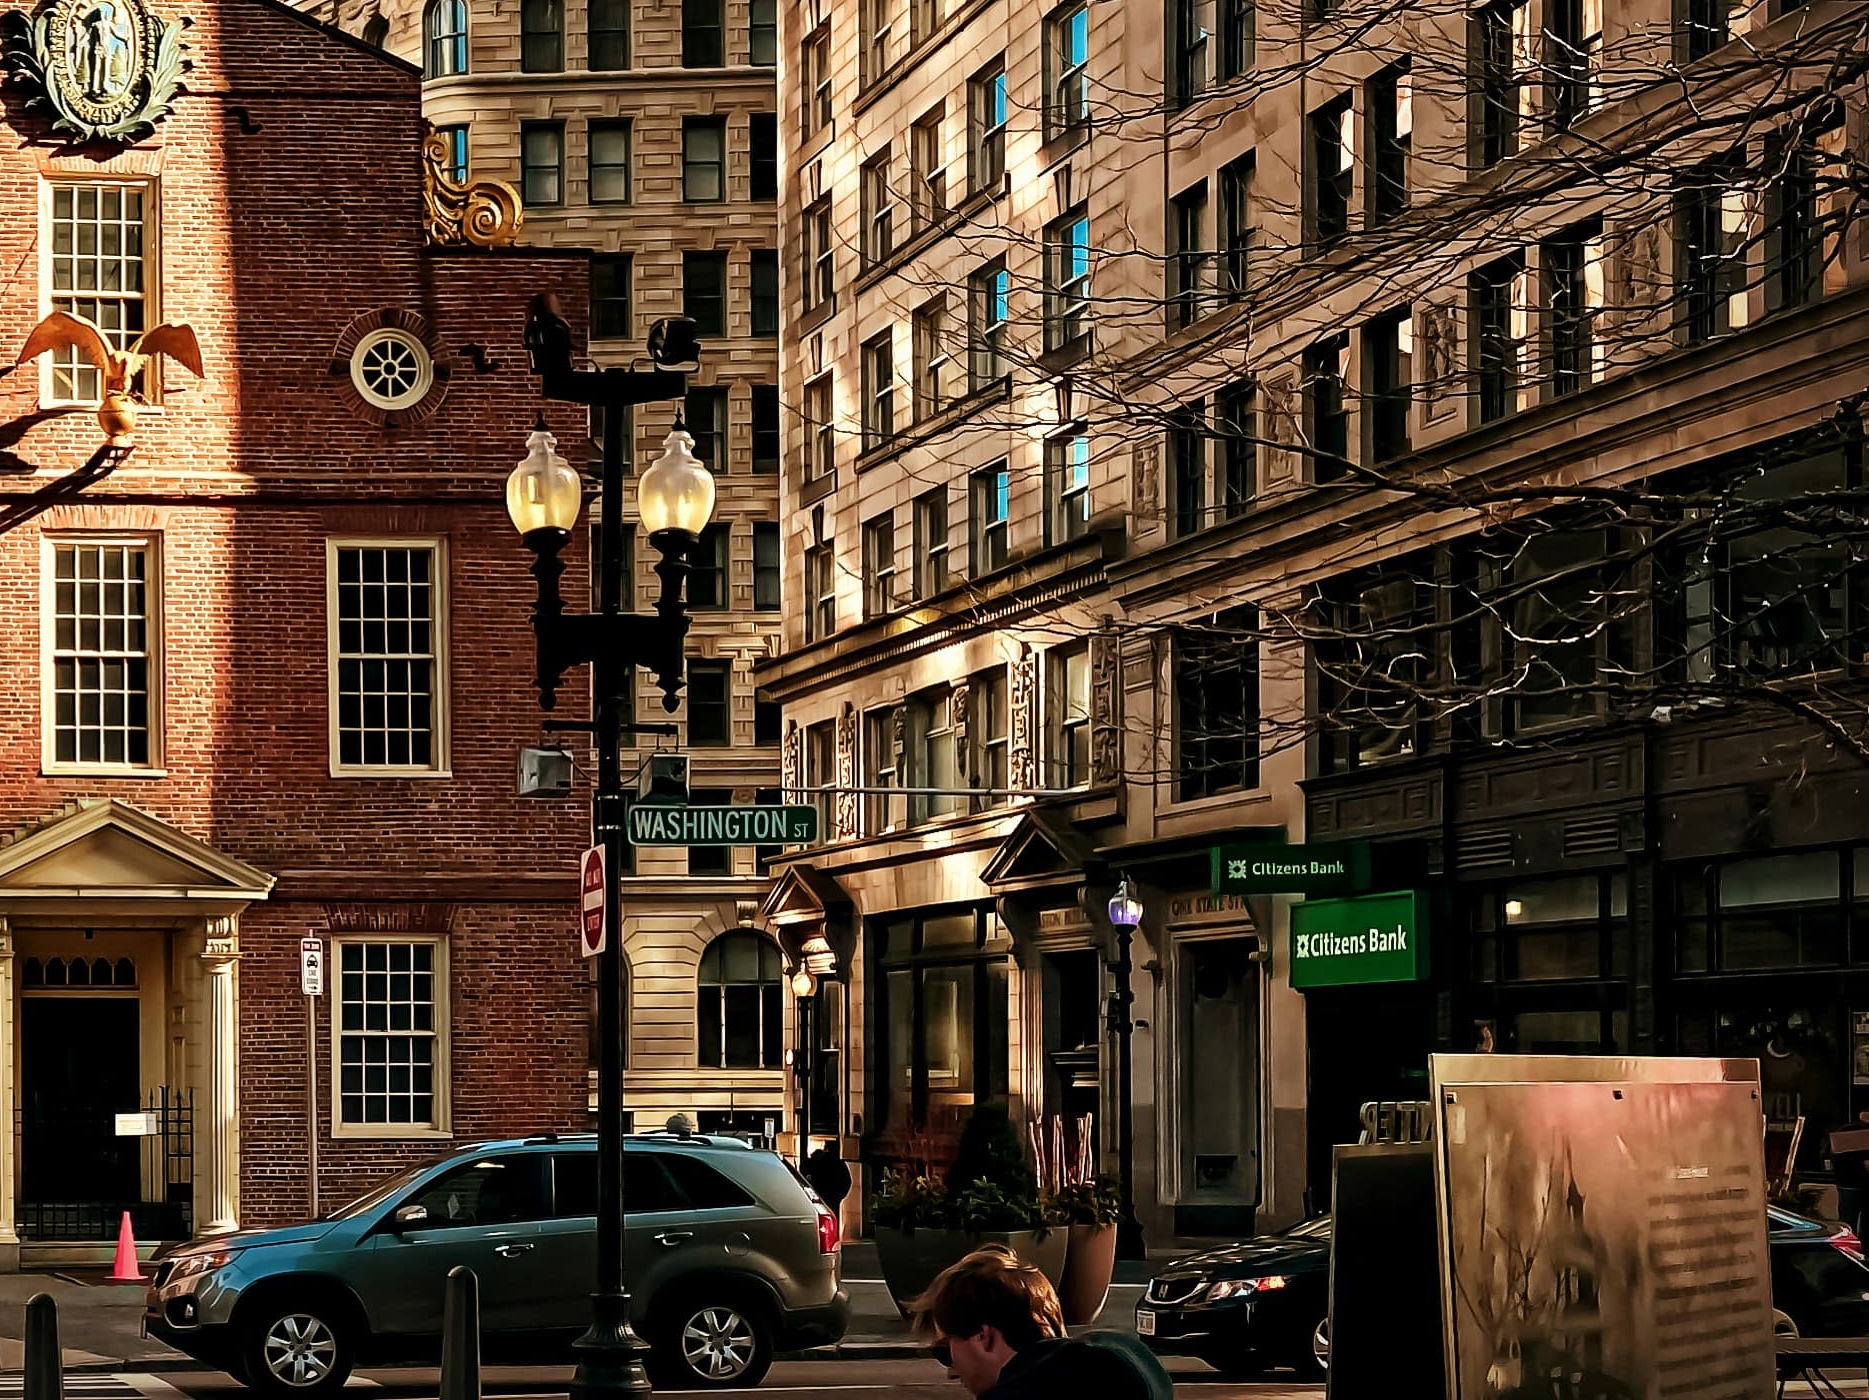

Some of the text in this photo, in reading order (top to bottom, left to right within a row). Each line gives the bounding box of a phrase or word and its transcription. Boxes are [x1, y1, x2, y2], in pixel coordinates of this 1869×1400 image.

[634, 810, 809, 840] WASHINGTON ST
[1252, 861, 1345, 875] Citizens Bank
[1310, 924, 1407, 958] Citizens Bank
